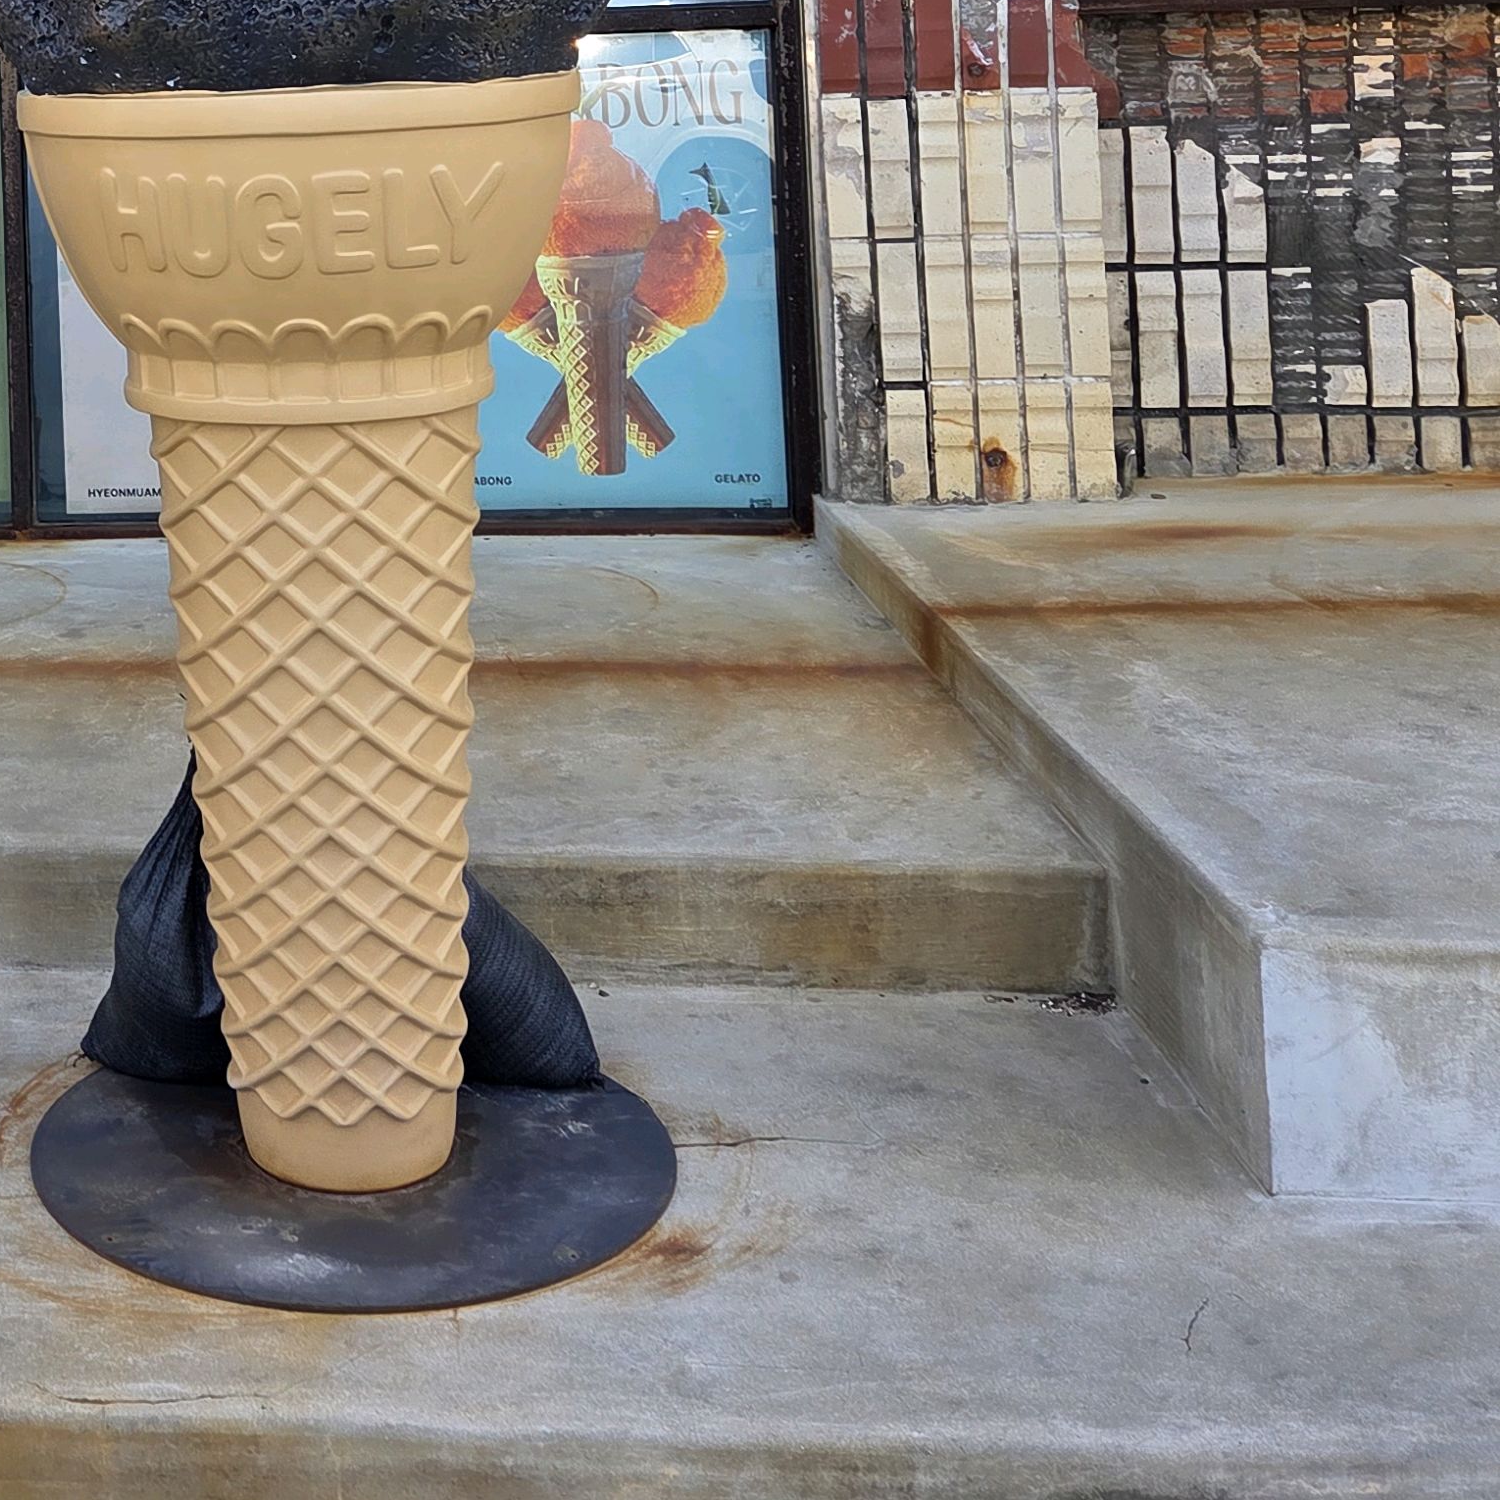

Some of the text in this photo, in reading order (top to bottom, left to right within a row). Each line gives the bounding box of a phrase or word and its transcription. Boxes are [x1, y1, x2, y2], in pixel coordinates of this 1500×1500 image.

[580, 58, 743, 129] BONG
[99, 161, 504, 279] HUGELY
[714, 473, 761, 484] GELATO
